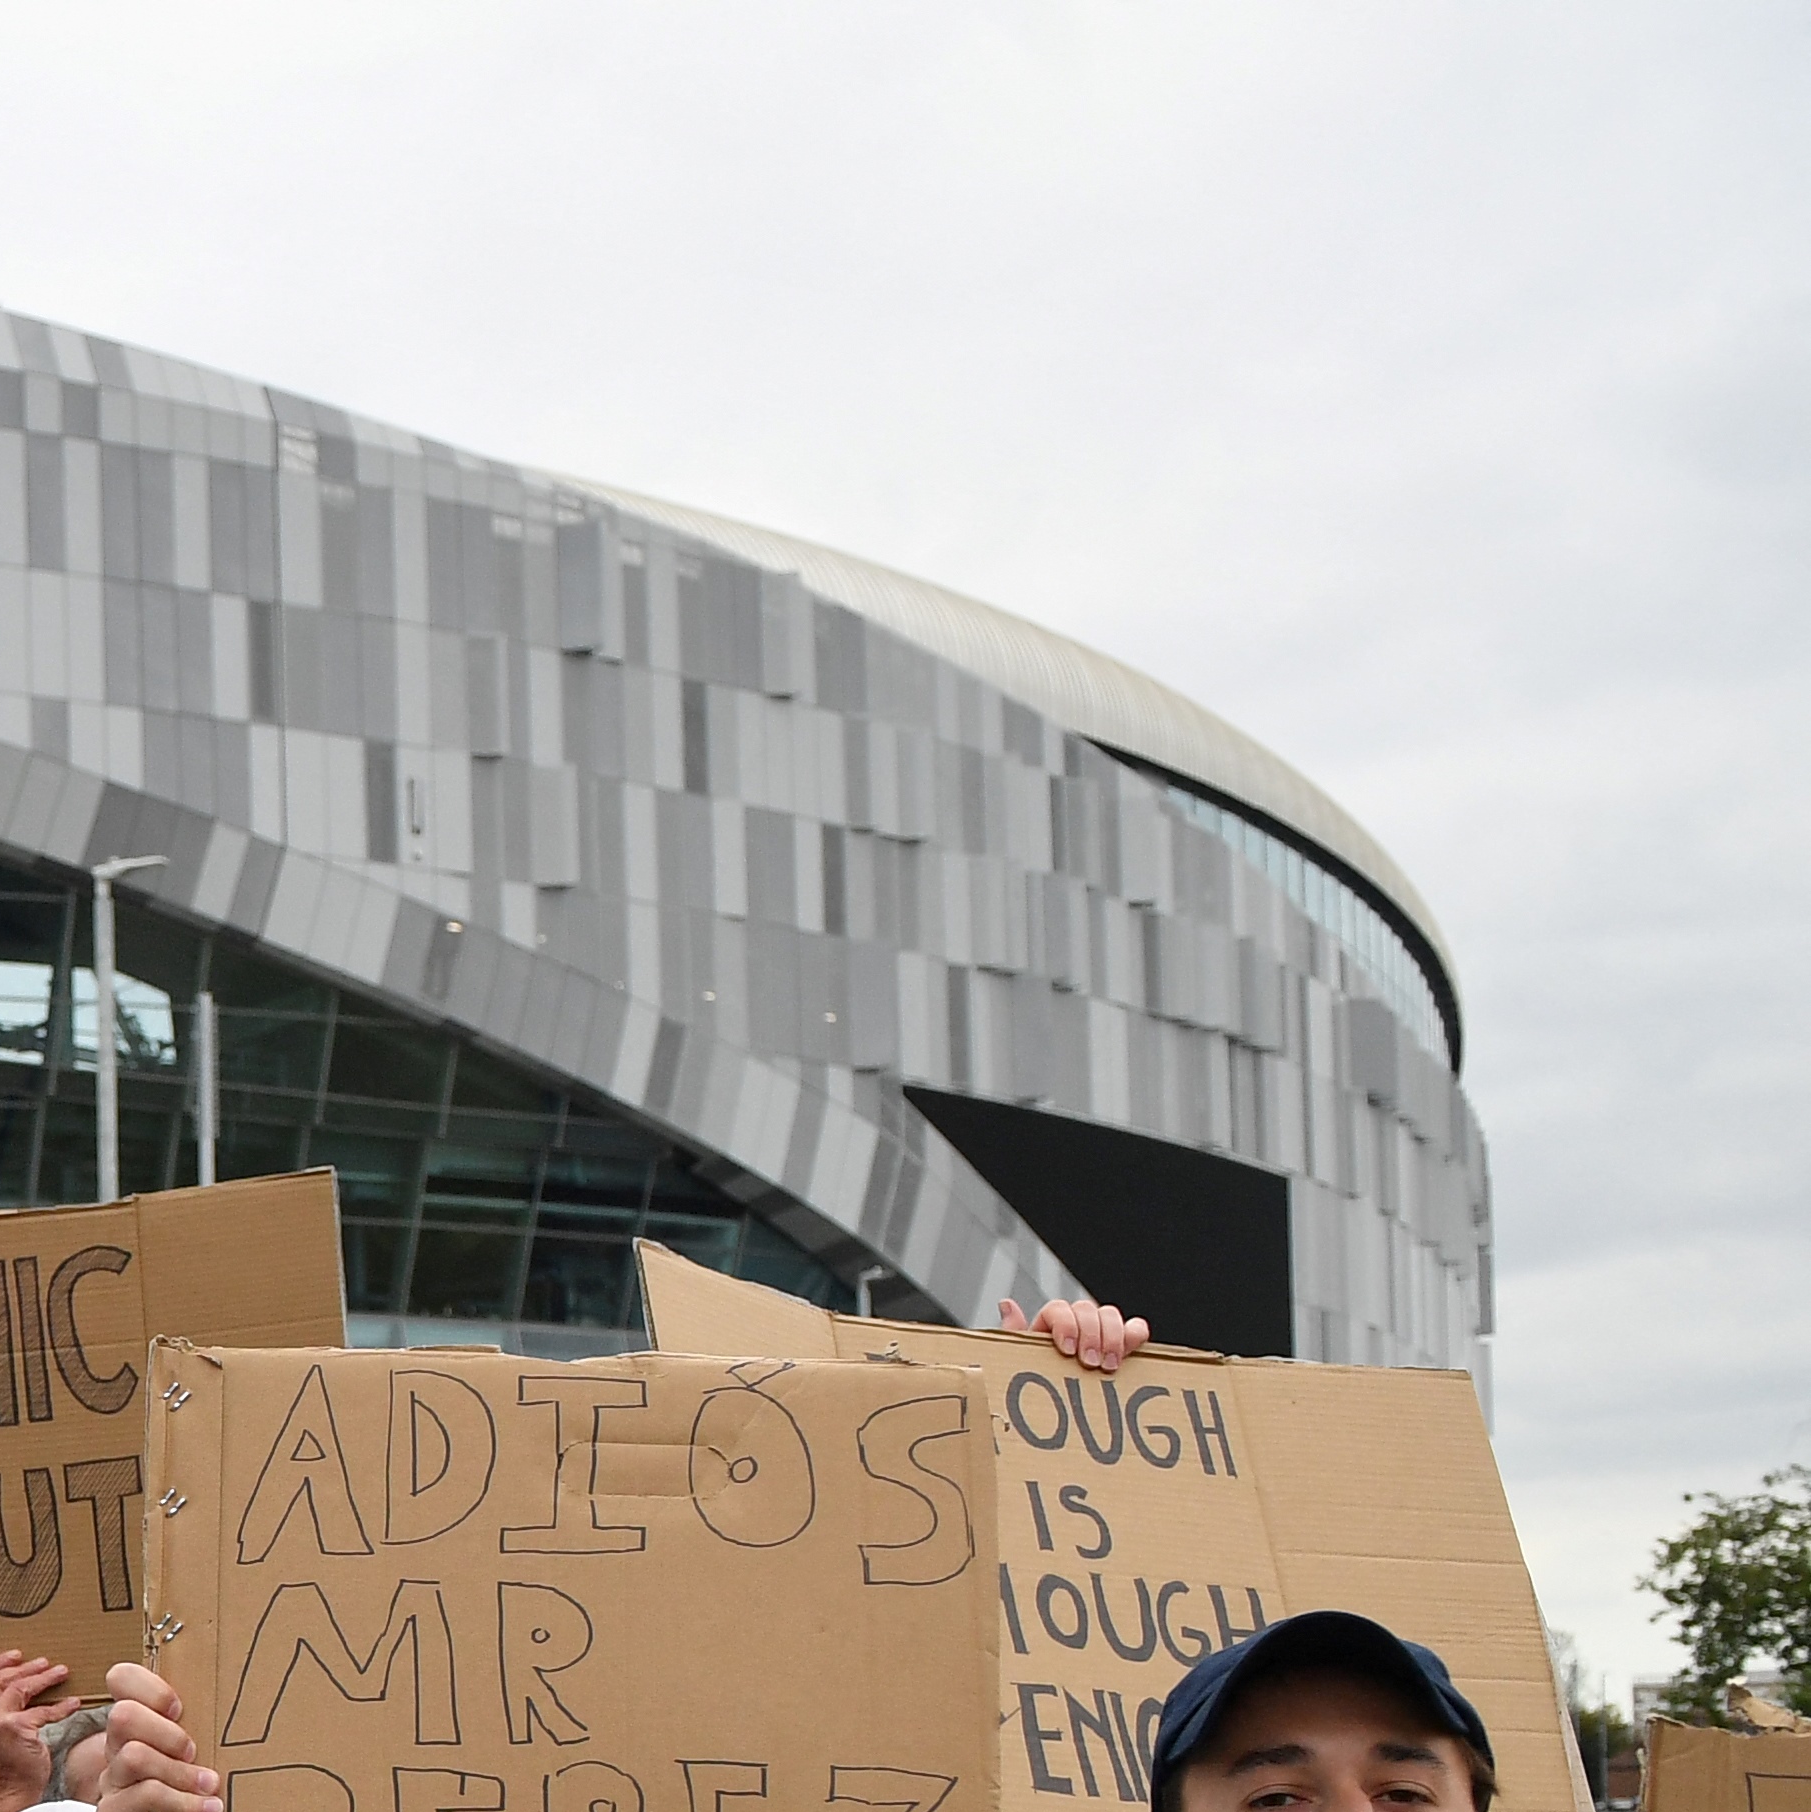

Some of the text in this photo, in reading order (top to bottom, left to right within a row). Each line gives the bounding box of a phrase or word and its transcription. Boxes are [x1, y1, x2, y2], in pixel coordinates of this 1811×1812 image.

[991, 1371, 1238, 1479] OUGH
[1025, 1481, 1113, 1560] IS
[221, 1580, 593, 1747] MR
